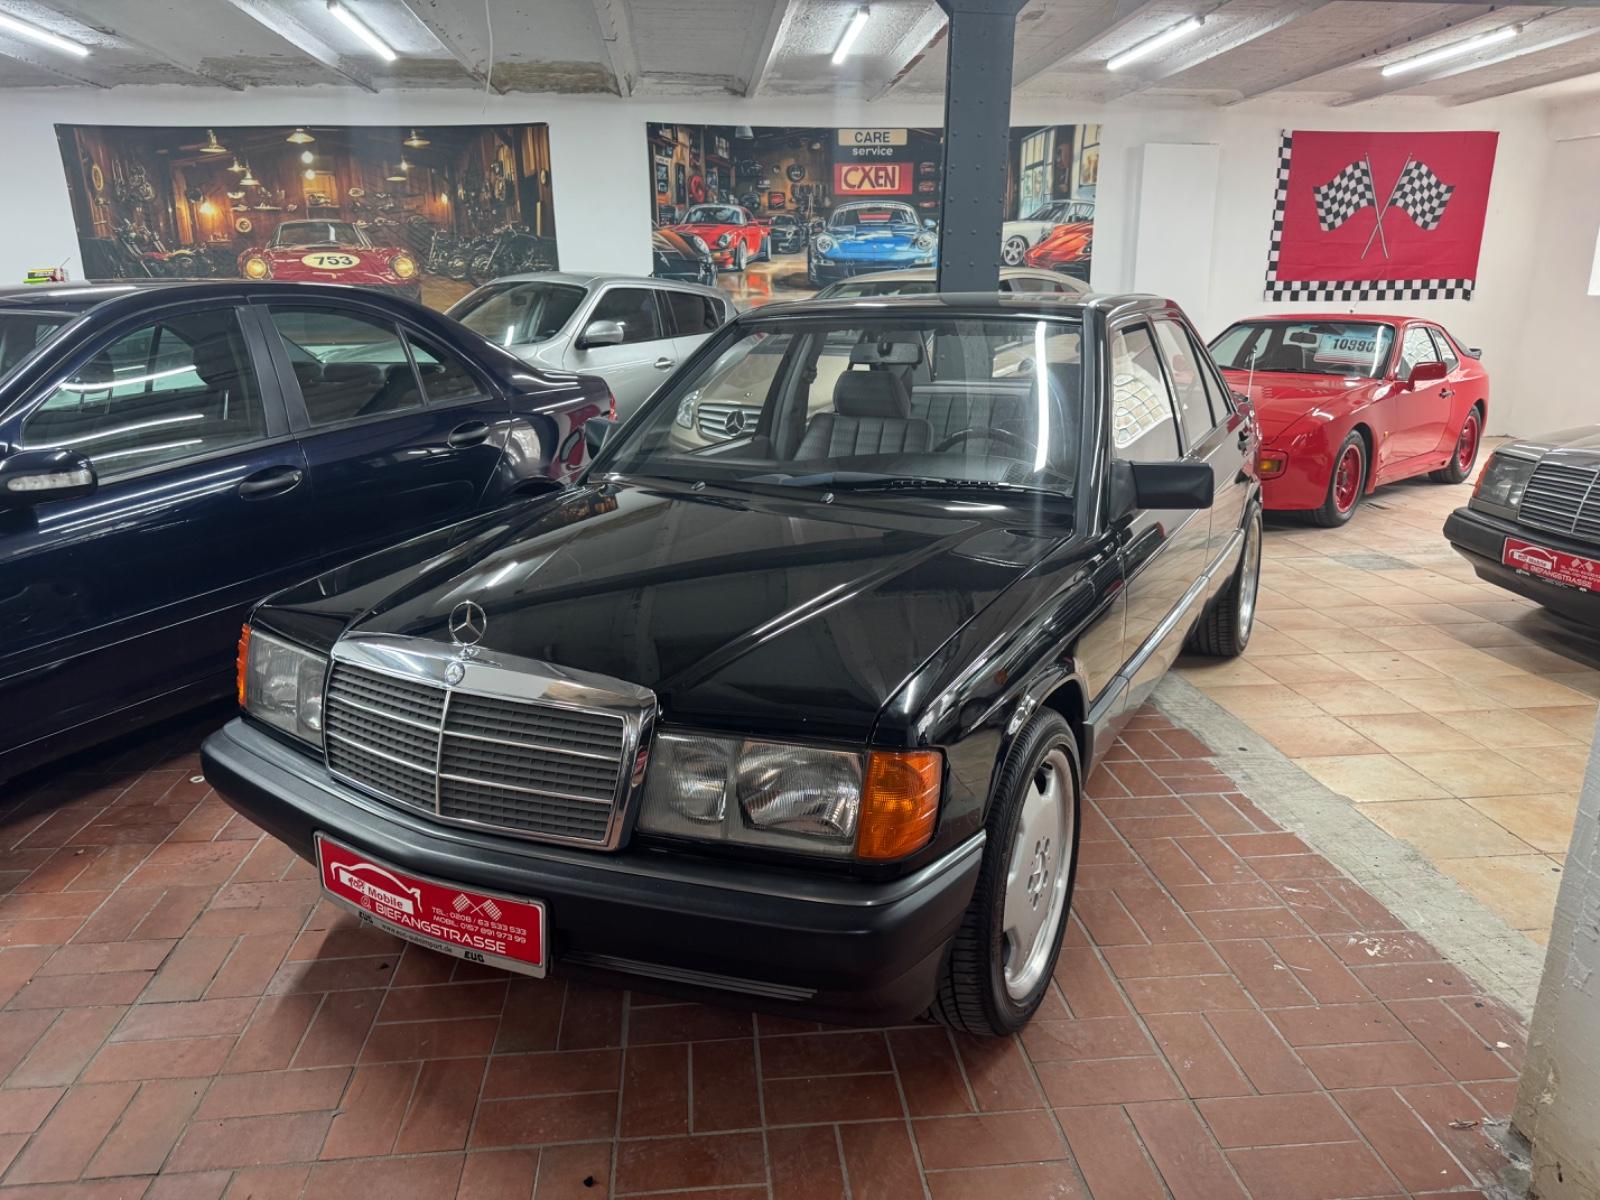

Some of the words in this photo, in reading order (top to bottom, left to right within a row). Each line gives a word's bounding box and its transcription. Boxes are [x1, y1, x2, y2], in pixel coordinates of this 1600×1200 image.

[854, 131, 890, 143] CARE
[852, 146, 893, 156] service
[843, 166, 896, 189] CXEN
[313, 256, 353, 265] 753
[368, 887, 403, 909] Mobile
[449, 912, 472, 923] 0208
[375, 902, 506, 954] BIEFANGSTRASSE
